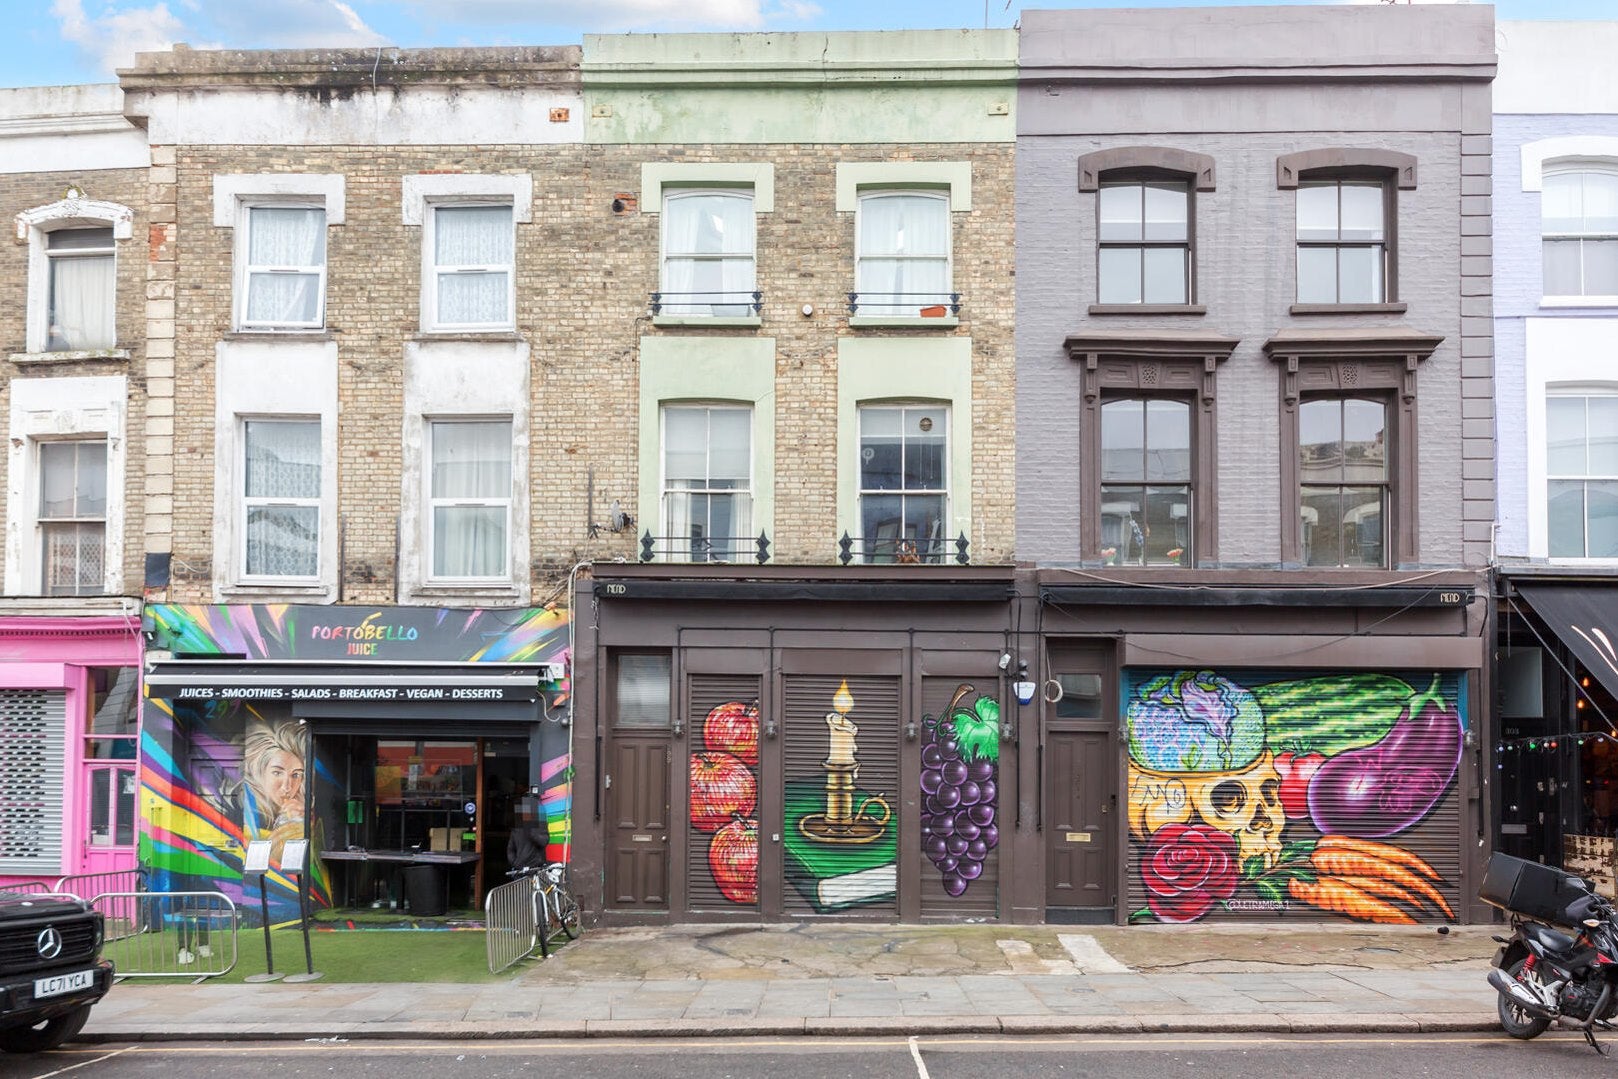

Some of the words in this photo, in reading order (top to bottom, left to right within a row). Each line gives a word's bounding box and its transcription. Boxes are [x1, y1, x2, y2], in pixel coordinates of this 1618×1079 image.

[311, 625, 419, 640] PORTOBELLO
[347, 642, 379, 656] JUICE
[179, 687, 214, 698] JUICES
[221, 687, 284, 698] SMOOTHIES
[291, 687, 331, 699] SALADS
[339, 688, 399, 699] BREAKFAST
[406, 688, 444, 699] VEGAN
[452, 688, 504, 699] DESSERTS
[42, 977, 66, 994] LC71
[68, 973, 87, 989] YCA
